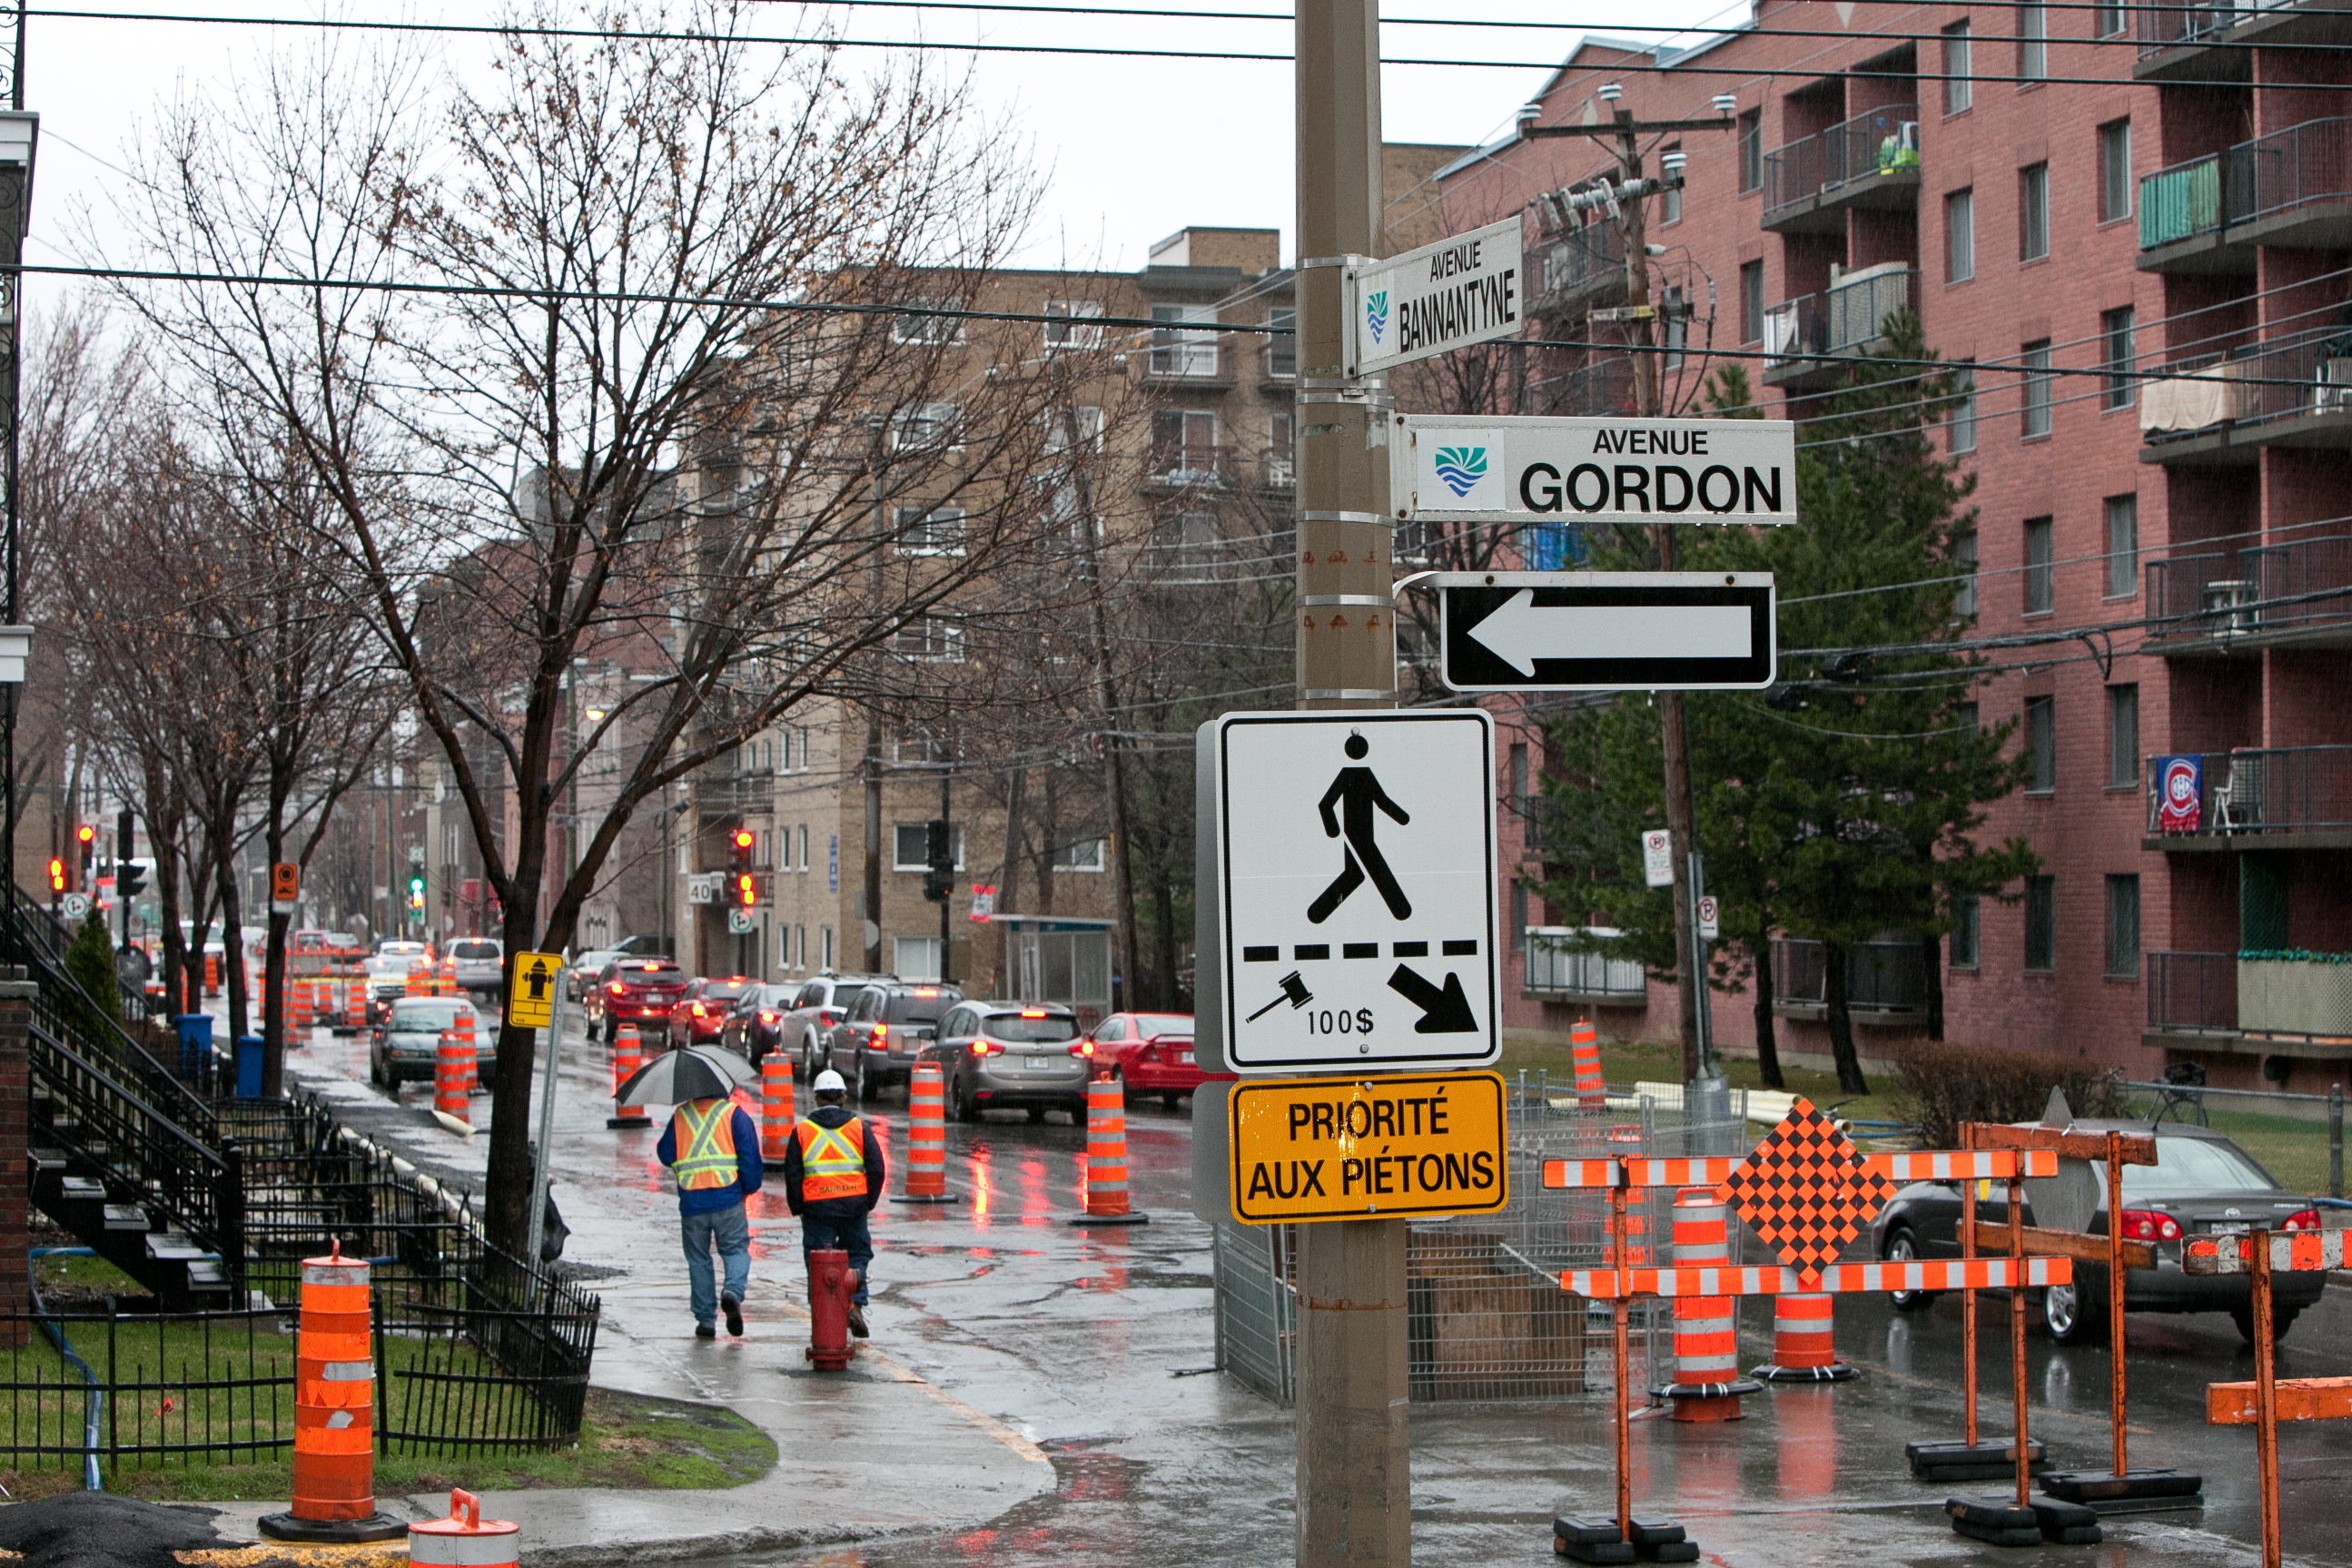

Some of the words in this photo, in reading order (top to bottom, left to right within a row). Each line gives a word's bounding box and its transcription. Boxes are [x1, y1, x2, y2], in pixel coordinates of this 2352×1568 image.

[1429, 241, 1481, 282] AVENUE
[1399, 269, 1516, 353] BANNANTYNE
[1592, 429, 1708, 455] AVENUE
[1519, 462, 1782, 514] GORDON
[690, 883, 710, 900] 40
[1308, 1007, 1374, 1037] 100$
[1289, 1086, 1449, 1141] PRIORITÉ
[1247, 1159, 1327, 1200] AUX
[1342, 1145, 1495, 1197] PIÉTONS
